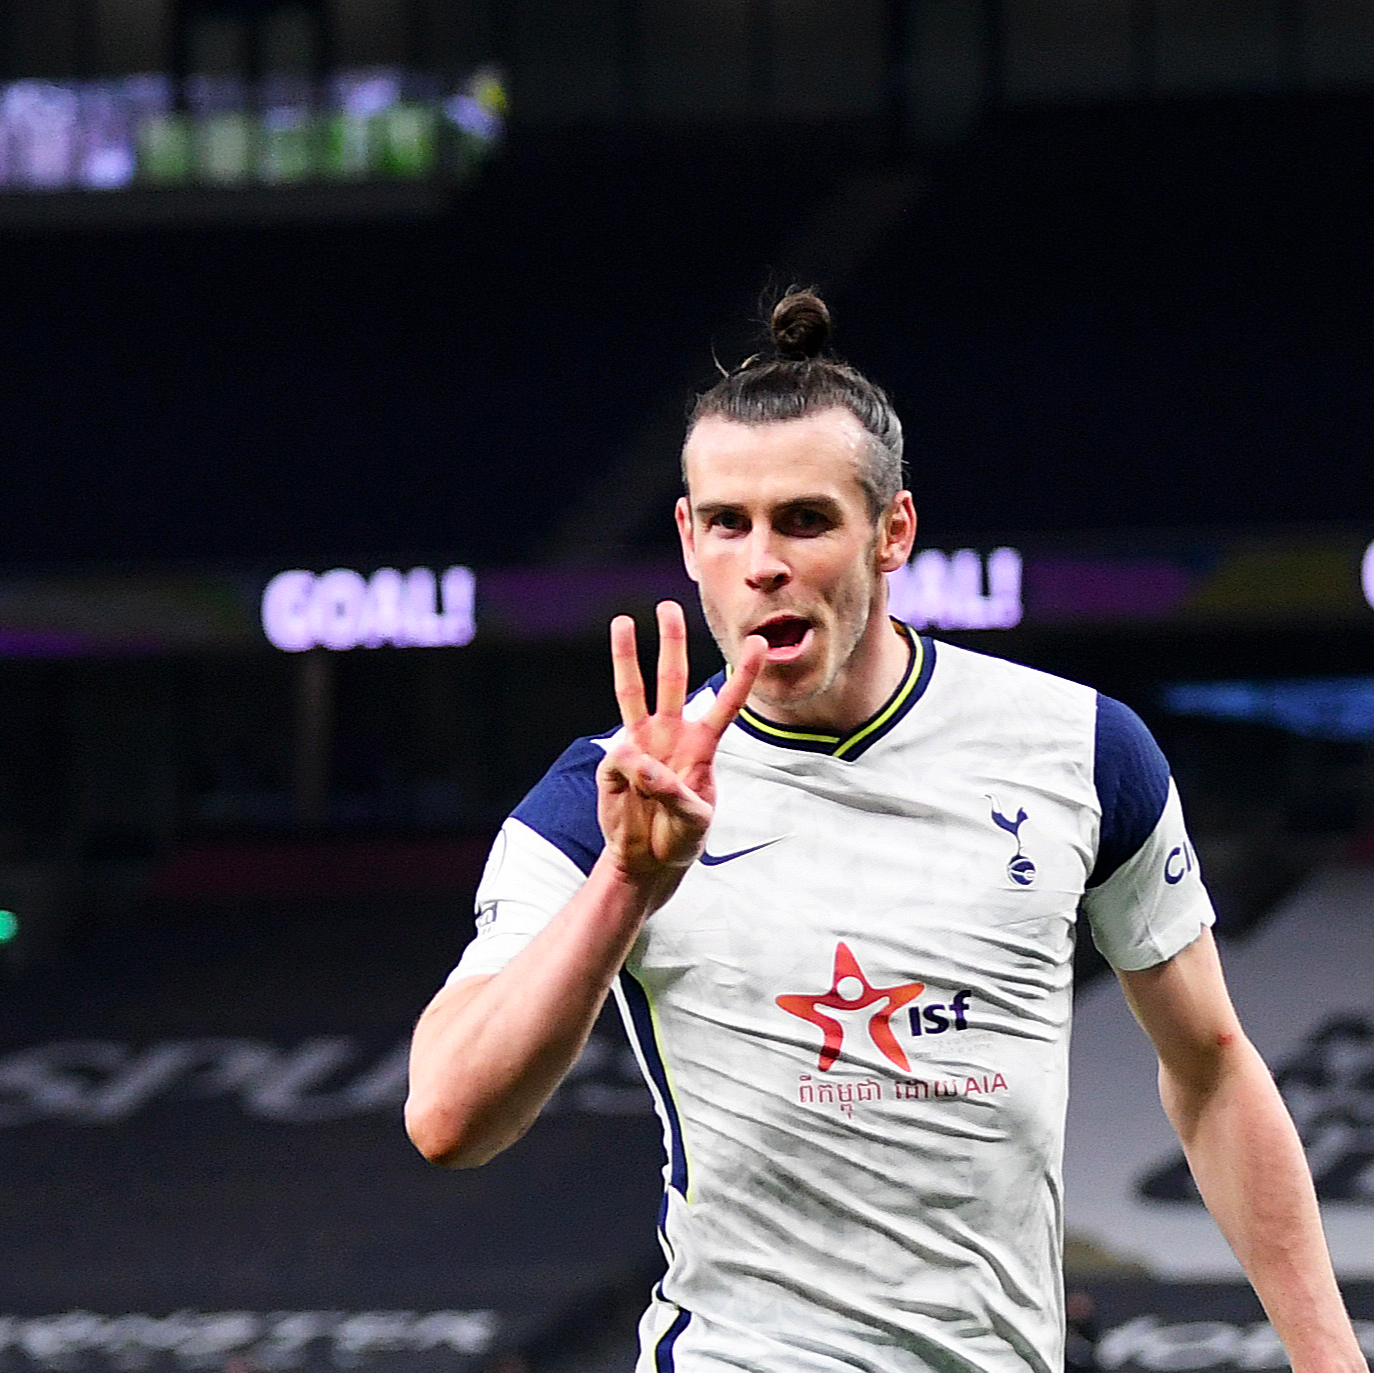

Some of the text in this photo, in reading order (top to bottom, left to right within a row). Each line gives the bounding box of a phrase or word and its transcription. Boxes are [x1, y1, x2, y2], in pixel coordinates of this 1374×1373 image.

[262, 565, 477, 652] GOAL!
[888, 547, 1024, 630] AL!
[964, 1073, 1009, 1096] AIA
